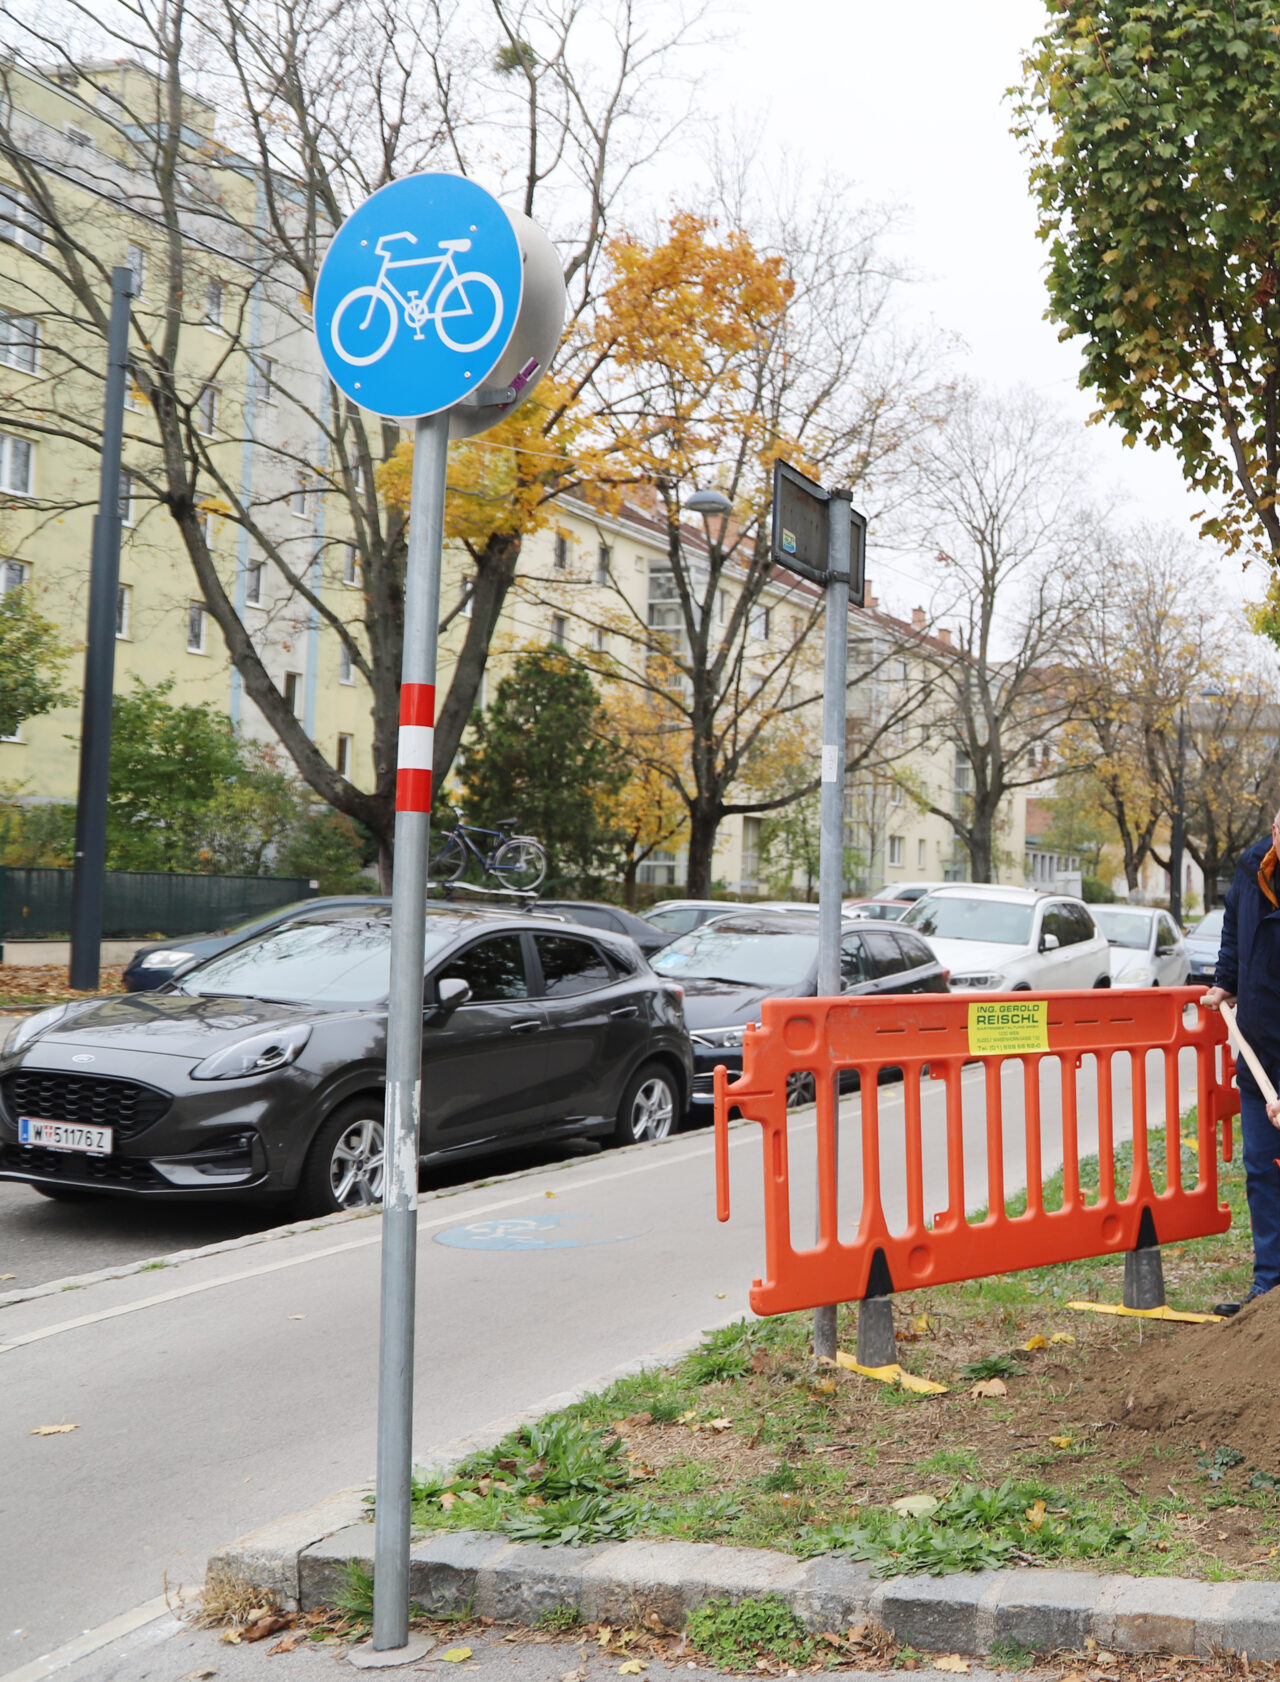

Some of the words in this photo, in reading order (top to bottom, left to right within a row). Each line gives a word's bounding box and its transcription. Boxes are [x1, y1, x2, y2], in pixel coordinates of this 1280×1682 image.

[999, 1005, 1040, 1013] GEROLD
[977, 1014, 1039, 1025] REISCHL
[33, 1124, 43, 1141] W
[53, 1126, 92, 1147] 51176
[97, 1132, 104, 1149] Z
